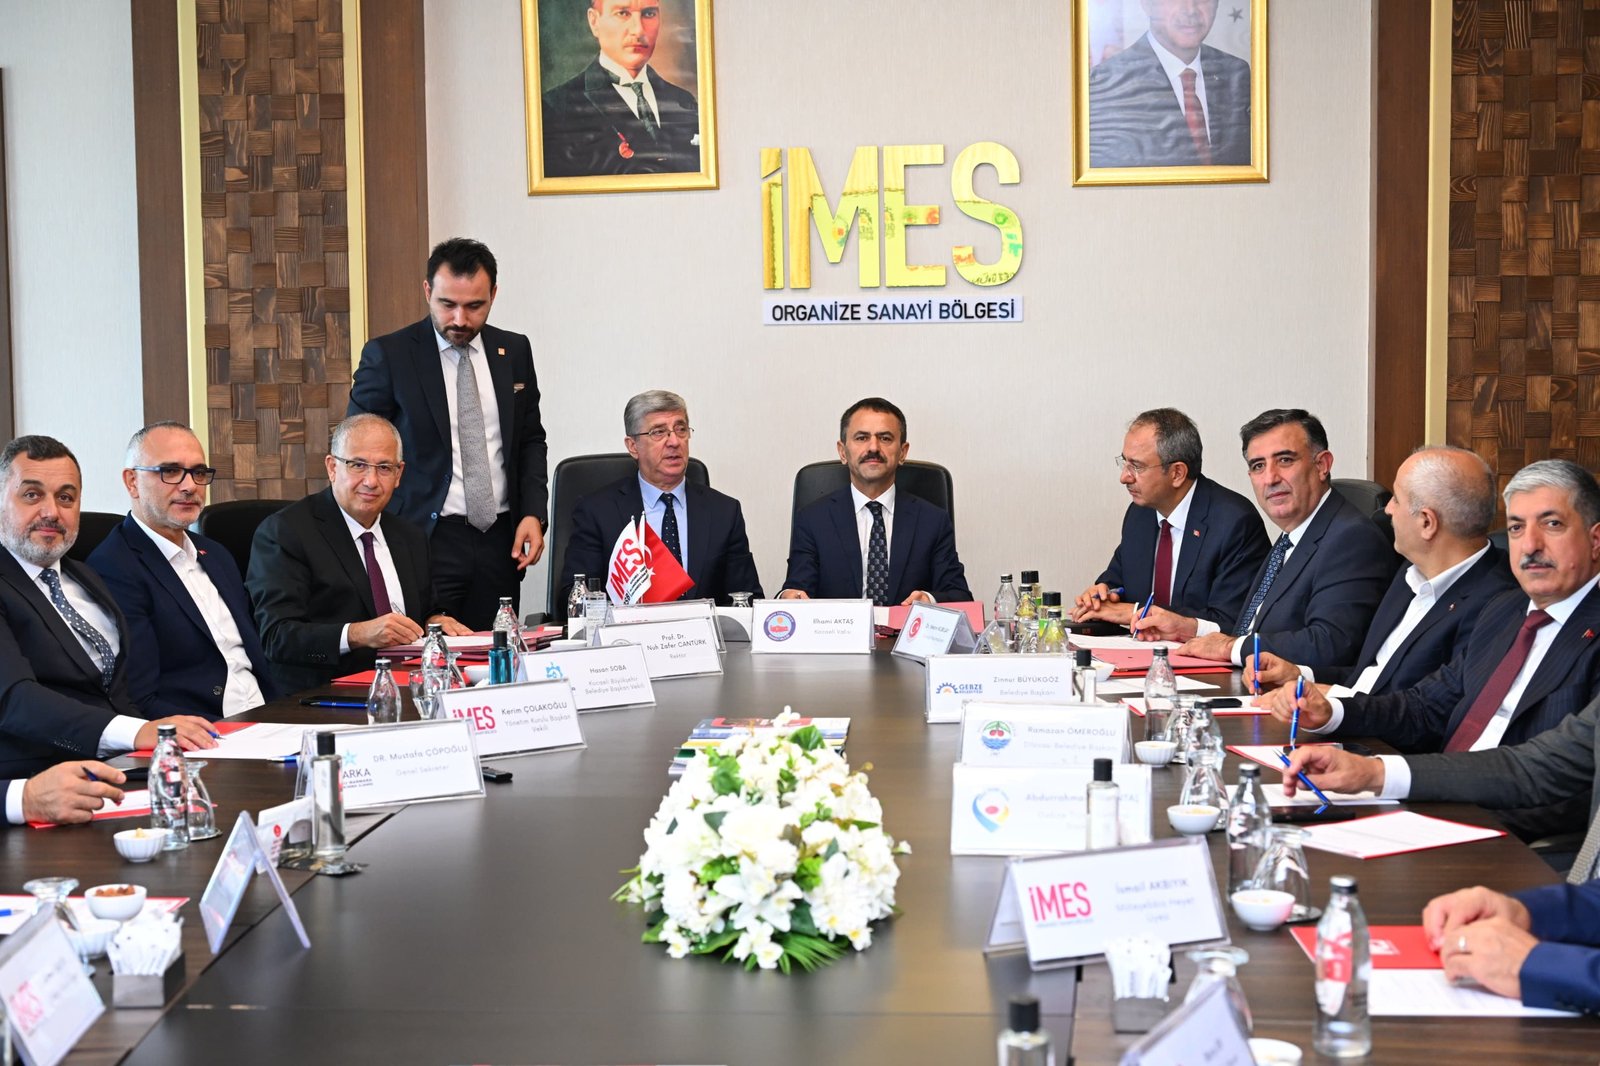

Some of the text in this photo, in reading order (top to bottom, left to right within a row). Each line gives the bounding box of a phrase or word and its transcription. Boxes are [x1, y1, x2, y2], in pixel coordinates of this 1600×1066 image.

[772, 299, 1015, 321] ORGANİZE SANAYİ BÖLGESİ
[661, 633, 676, 641] Prof.
[646, 638, 706, 651] Nuh Zafer CANTÜRK
[590, 664, 627, 674] Hasan SOBA
[501, 701, 568, 716] Kerim ÇOLAKOĞLU
[372, 754, 387, 763] DR.
[389, 749, 423, 761] Mustafa
[342, 768, 372, 779] ARKA
